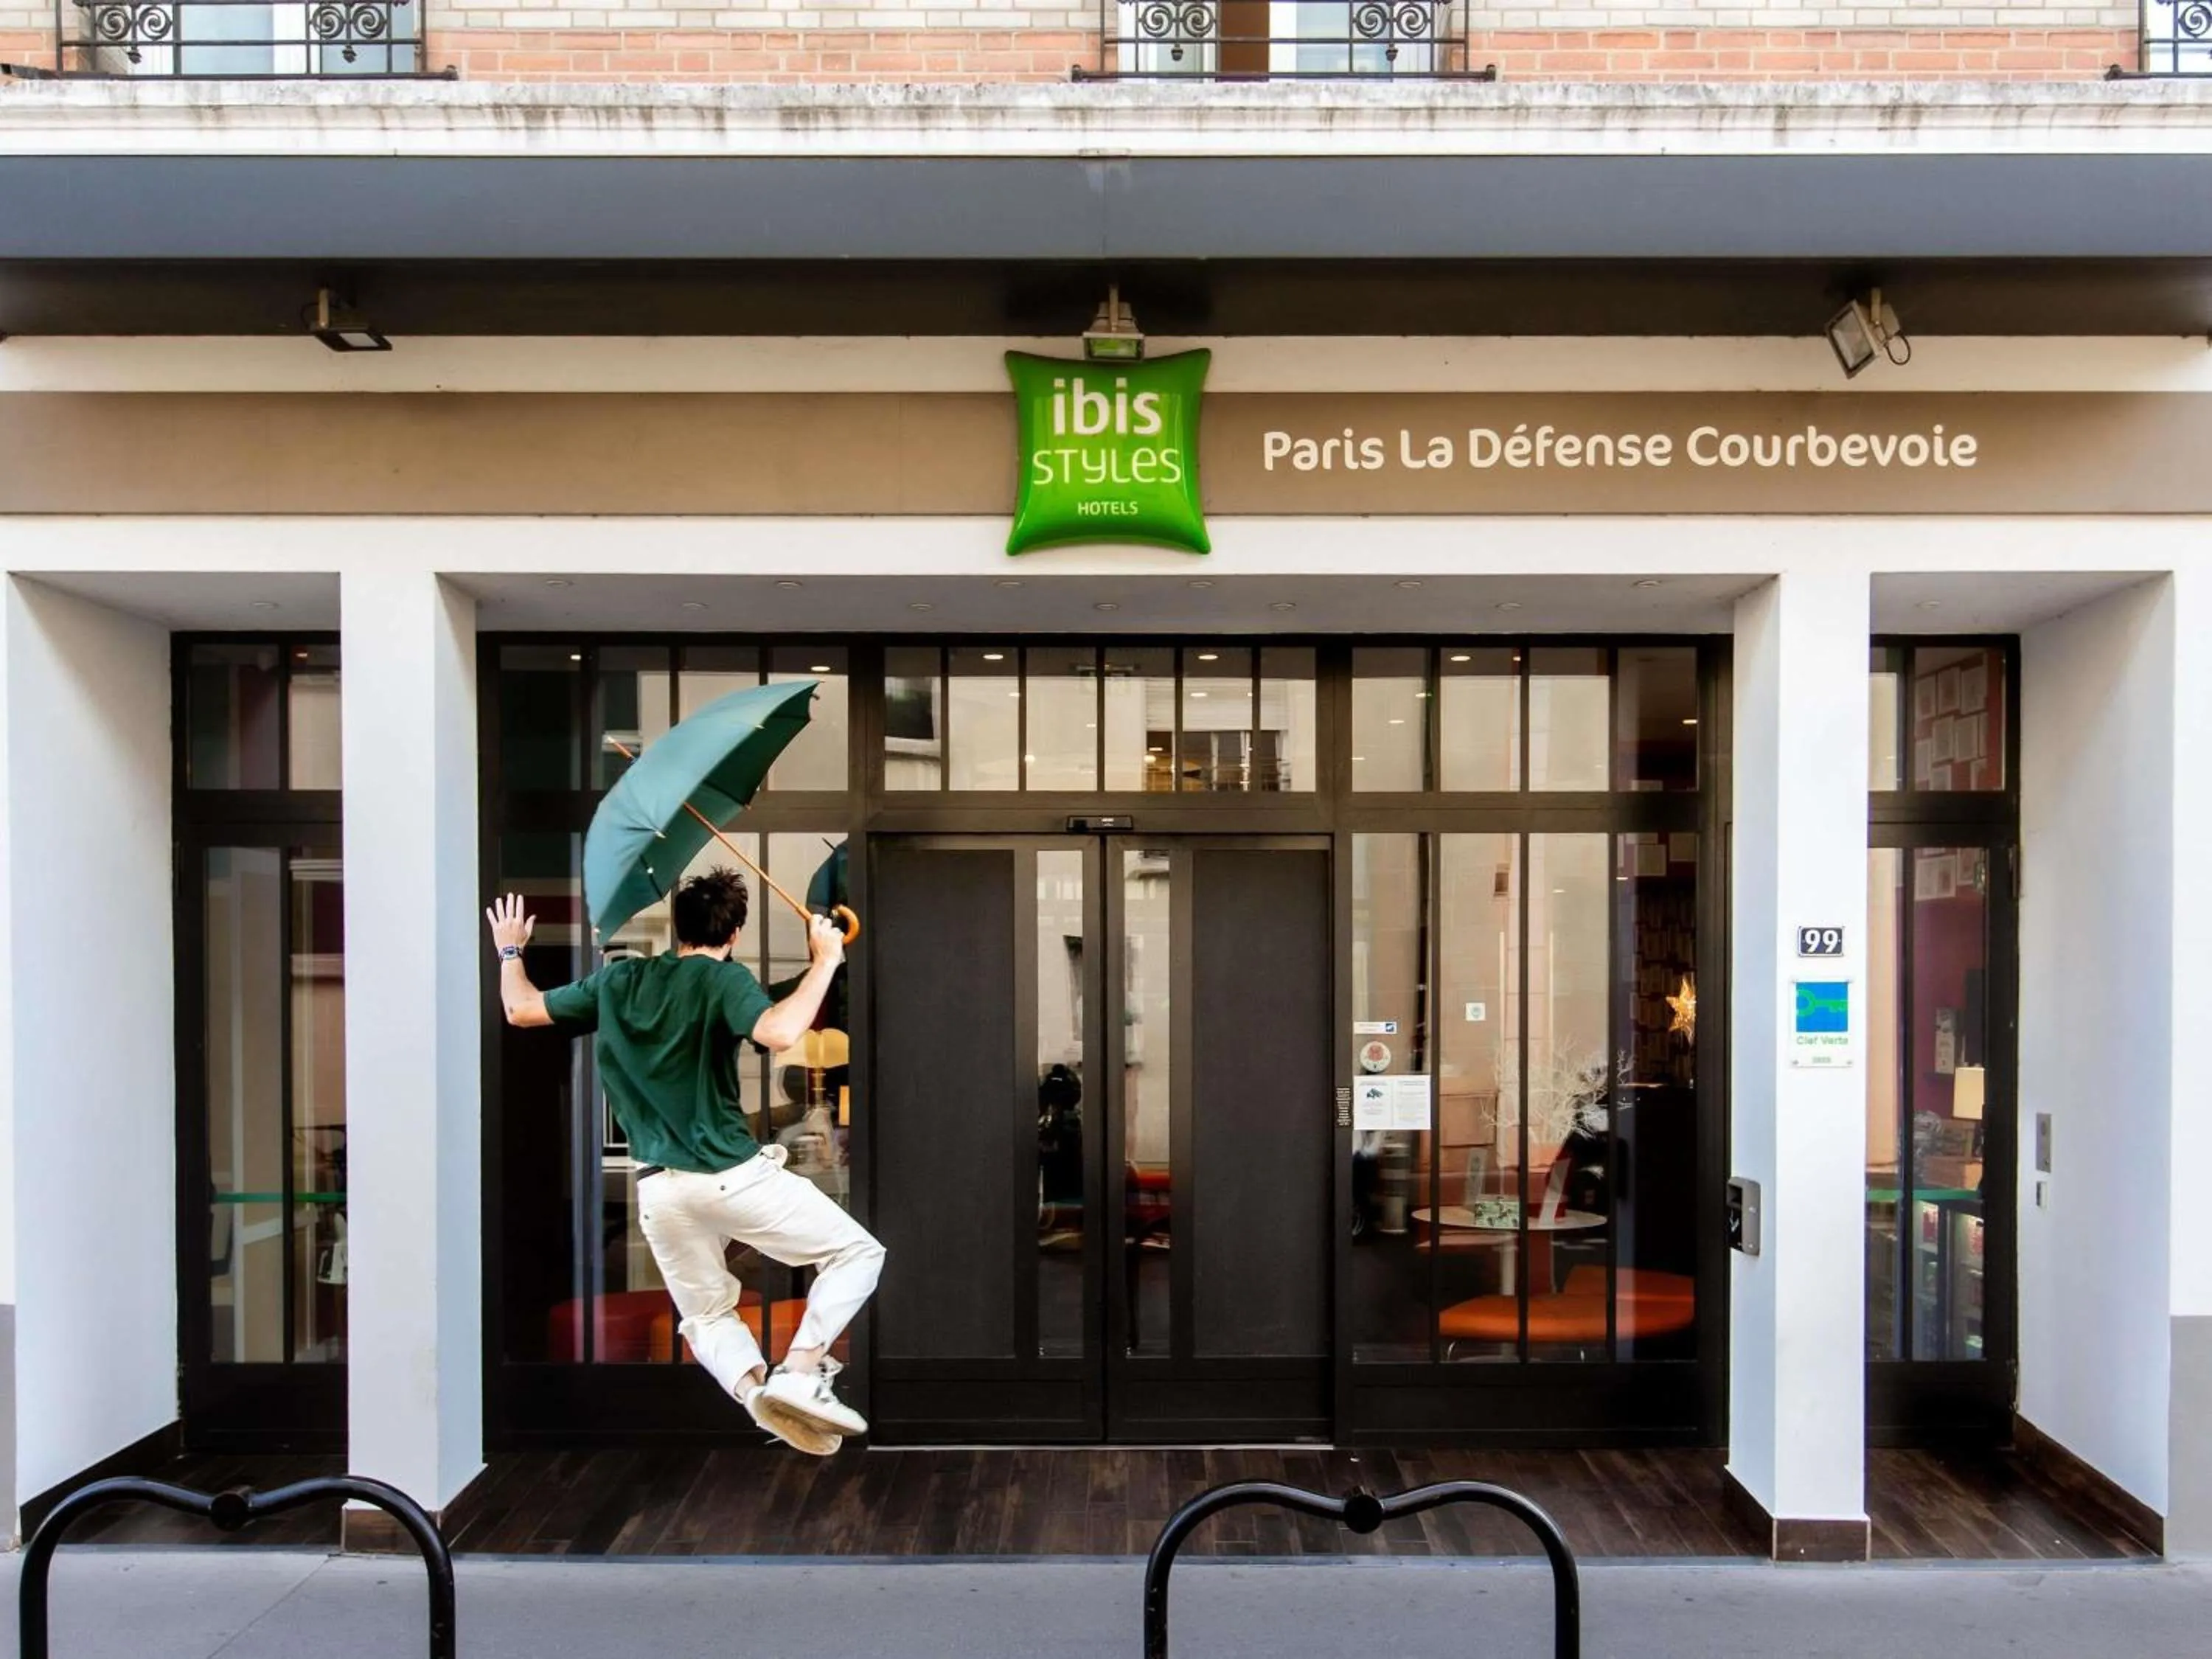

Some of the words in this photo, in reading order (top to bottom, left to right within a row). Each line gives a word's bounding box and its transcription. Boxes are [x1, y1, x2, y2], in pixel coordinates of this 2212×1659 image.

[1054, 378, 1162, 435] ibis
[1264, 428, 1385, 471] Paris
[1400, 429, 1453, 469] La
[1469, 424, 1672, 468] Défense
[1686, 424, 1978, 467] Courbevoie
[1077, 501, 1138, 515] HOTELS
[1804, 929, 1839, 953] 99
